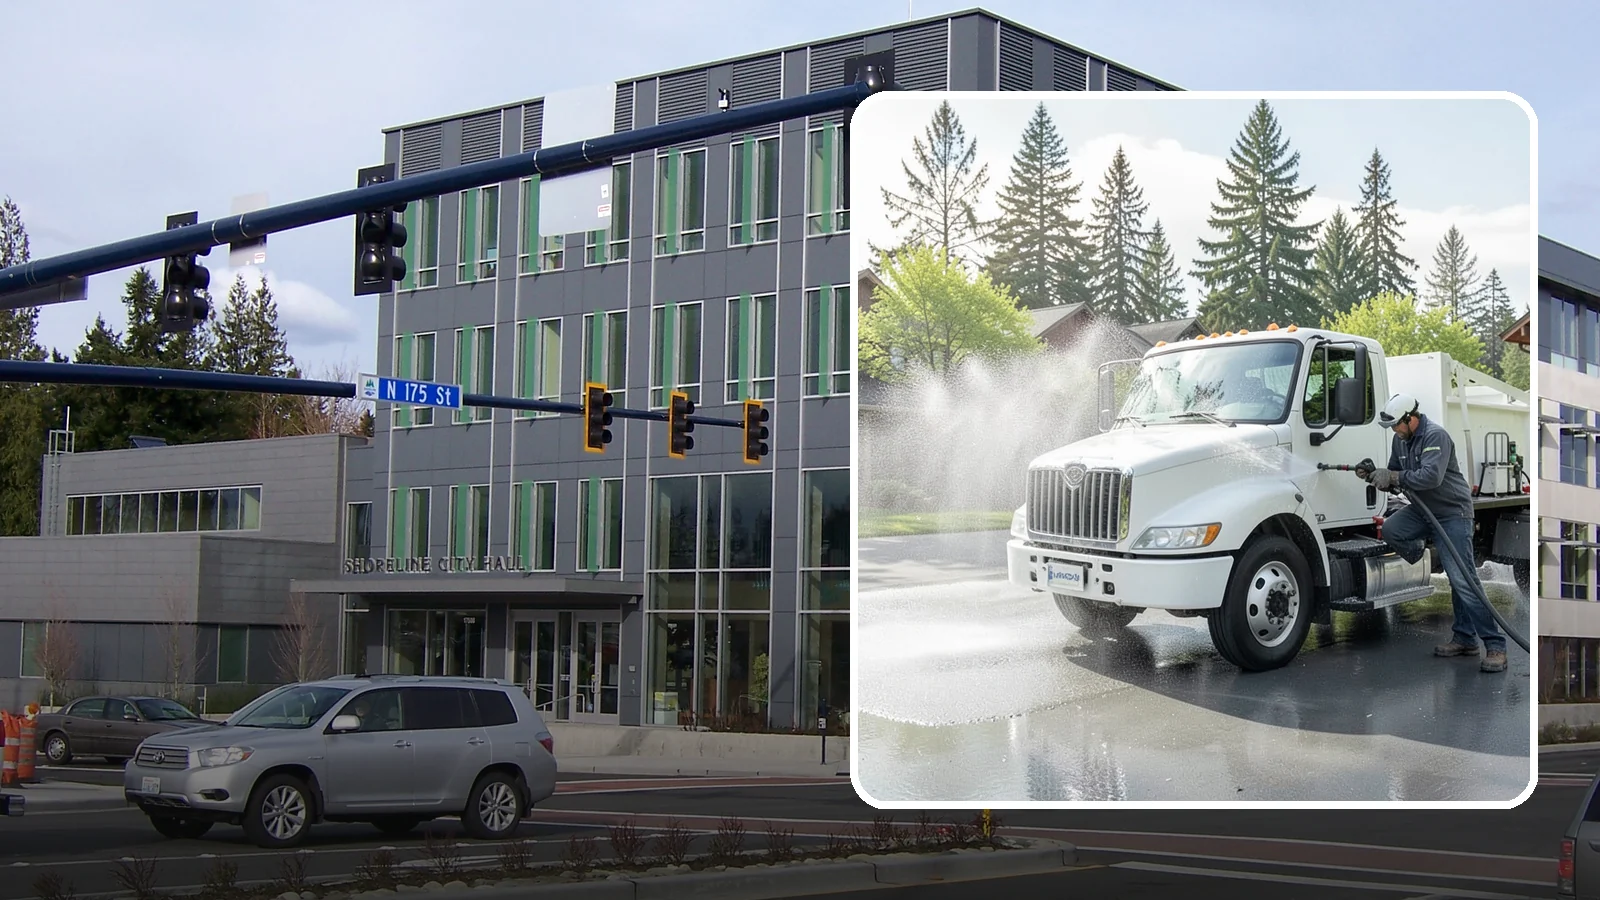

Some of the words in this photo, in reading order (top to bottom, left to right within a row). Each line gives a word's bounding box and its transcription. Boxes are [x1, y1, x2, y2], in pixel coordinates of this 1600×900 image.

[387, 380, 396, 399] N
[405, 382, 428, 403] 175
[436, 386, 451, 406] St
[344, 557, 432, 574] SHORELINE
[438, 556, 475, 572] CITY
[483, 556, 526, 571] HALL
